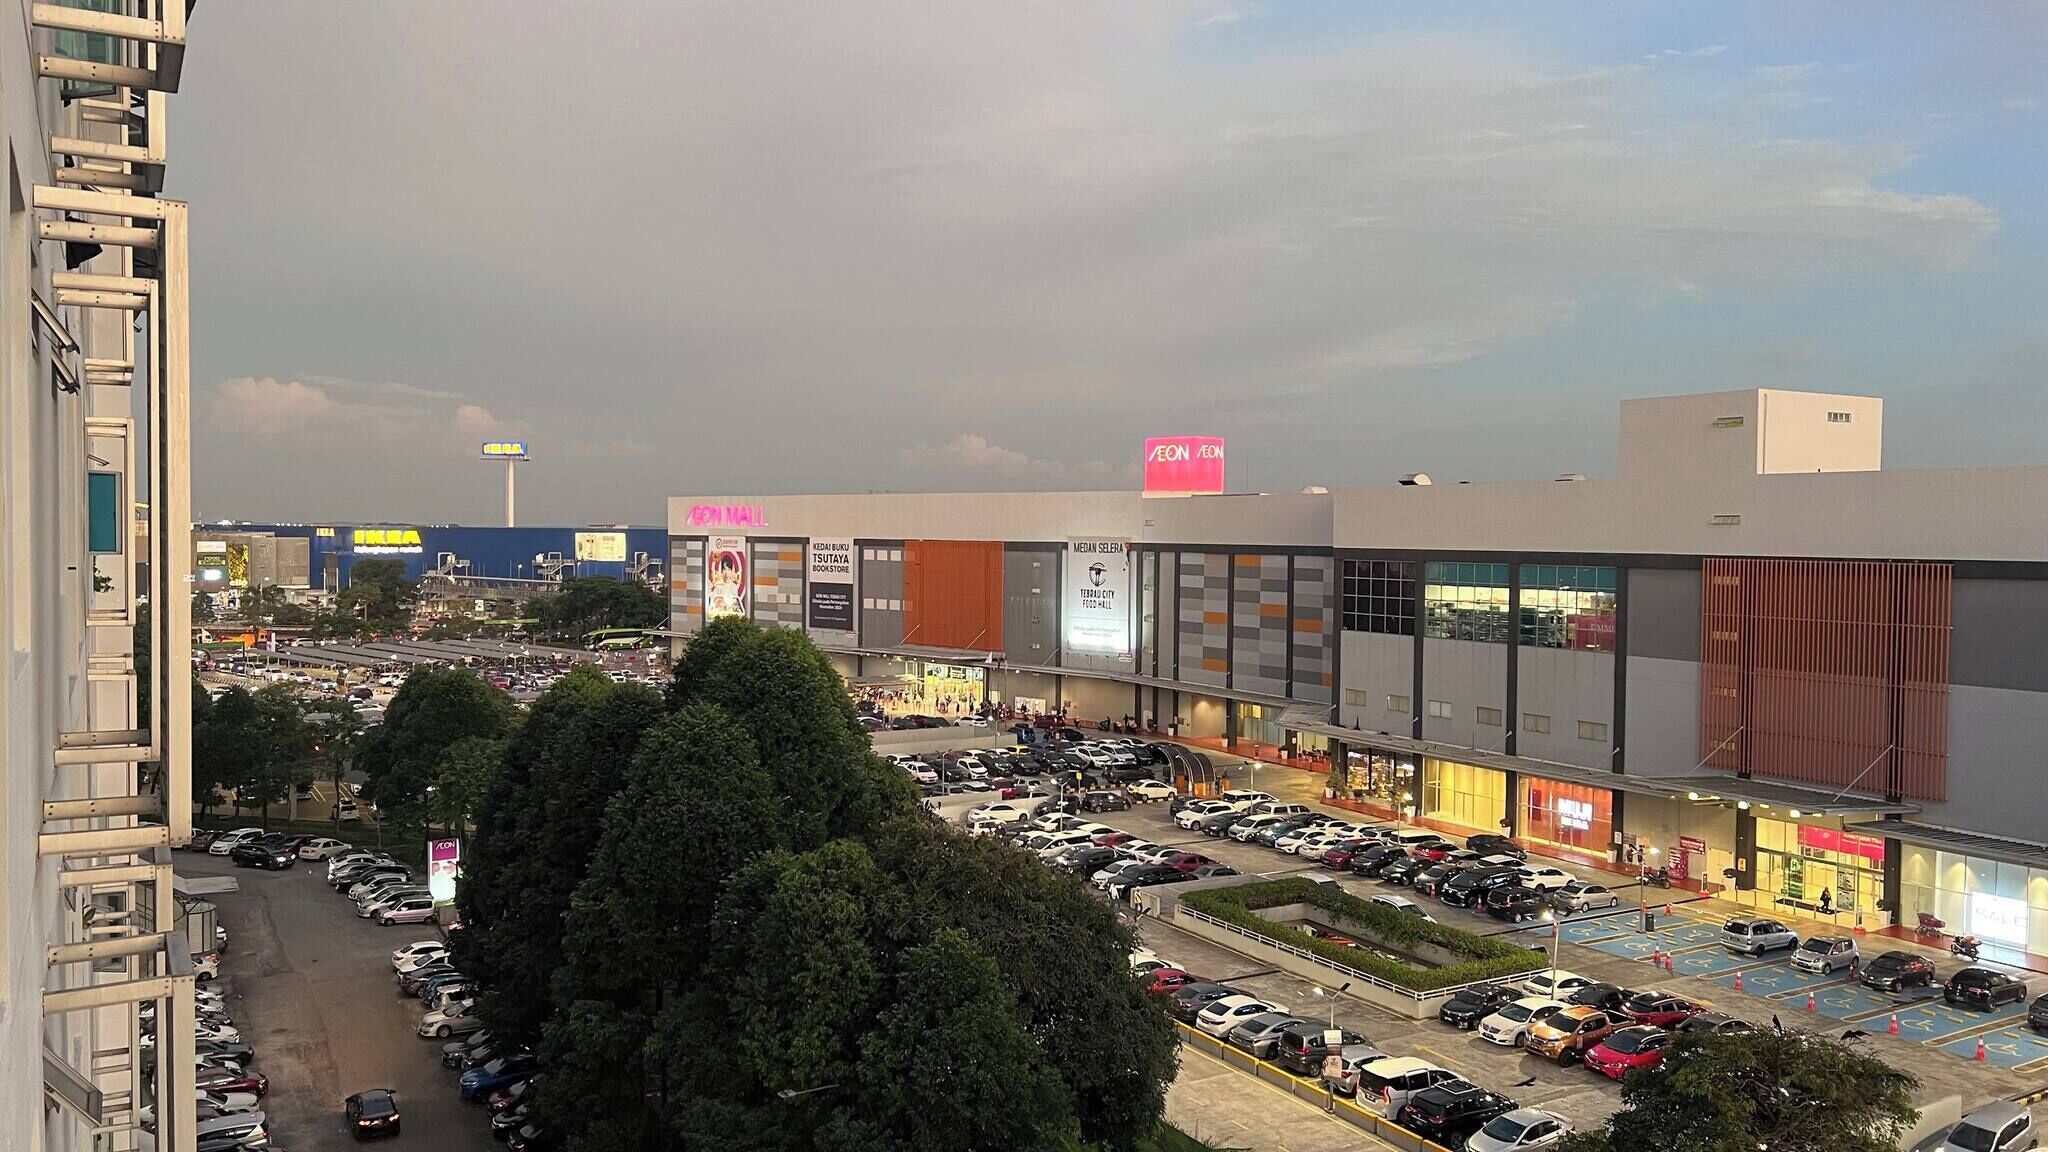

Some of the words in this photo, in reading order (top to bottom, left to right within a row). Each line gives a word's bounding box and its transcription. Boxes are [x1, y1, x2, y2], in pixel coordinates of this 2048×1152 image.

[726, 504, 768, 527] MALL
[354, 530, 421, 544] IKEA
[813, 543, 831, 551] KEDAI
[1073, 542, 1097, 553] MEDAN
[1098, 543, 1124, 554] SELERA
[813, 554, 850, 564] TSUTAYA
[812, 565, 850, 573] BOOKSTORE
[1080, 589, 1101, 599] TEBRAU
[1102, 590, 1116, 599] CITY
[1082, 600, 1097, 609] FOOD
[1098, 601, 1112, 610] HALL
